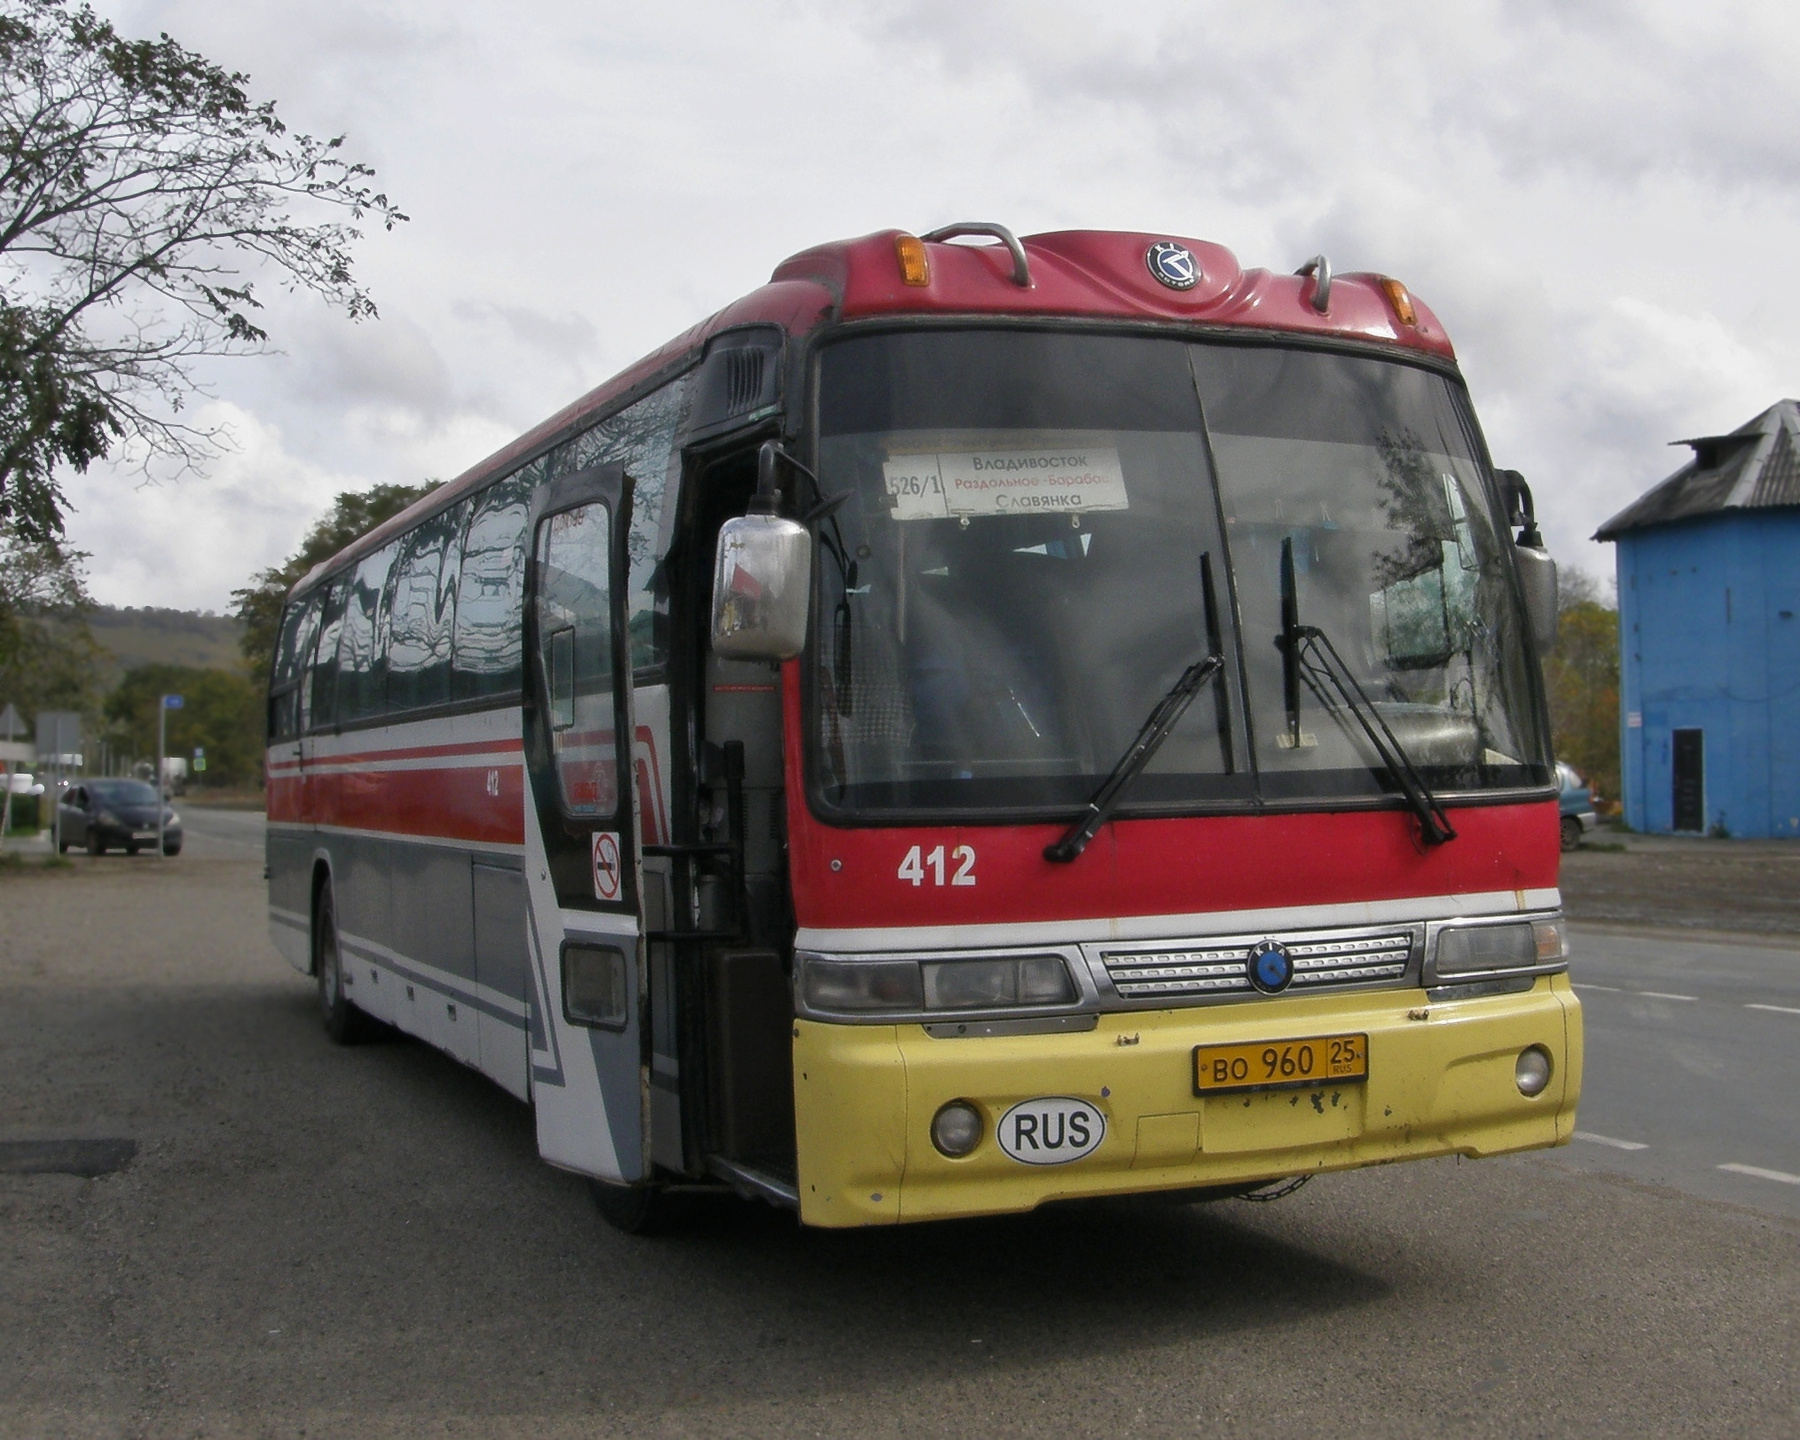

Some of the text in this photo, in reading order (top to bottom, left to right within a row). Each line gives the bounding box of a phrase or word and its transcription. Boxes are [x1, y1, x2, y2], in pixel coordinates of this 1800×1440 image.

[1155, 243, 1189, 258] KIA
[973, 456, 1088, 471] Владивосток
[889, 475, 941, 498] 526/1
[955, 477, 1039, 490] Раздольное
[996, 494, 1082, 508] Славянка
[897, 845, 976, 886] 412
[1254, 942, 1286, 957] KIA
[1262, 1045, 1313, 1078] 960
[1330, 1040, 1355, 1064] 25
[1333, 1064, 1353, 1073] RUS
[1015, 1111, 1090, 1150] RUS
